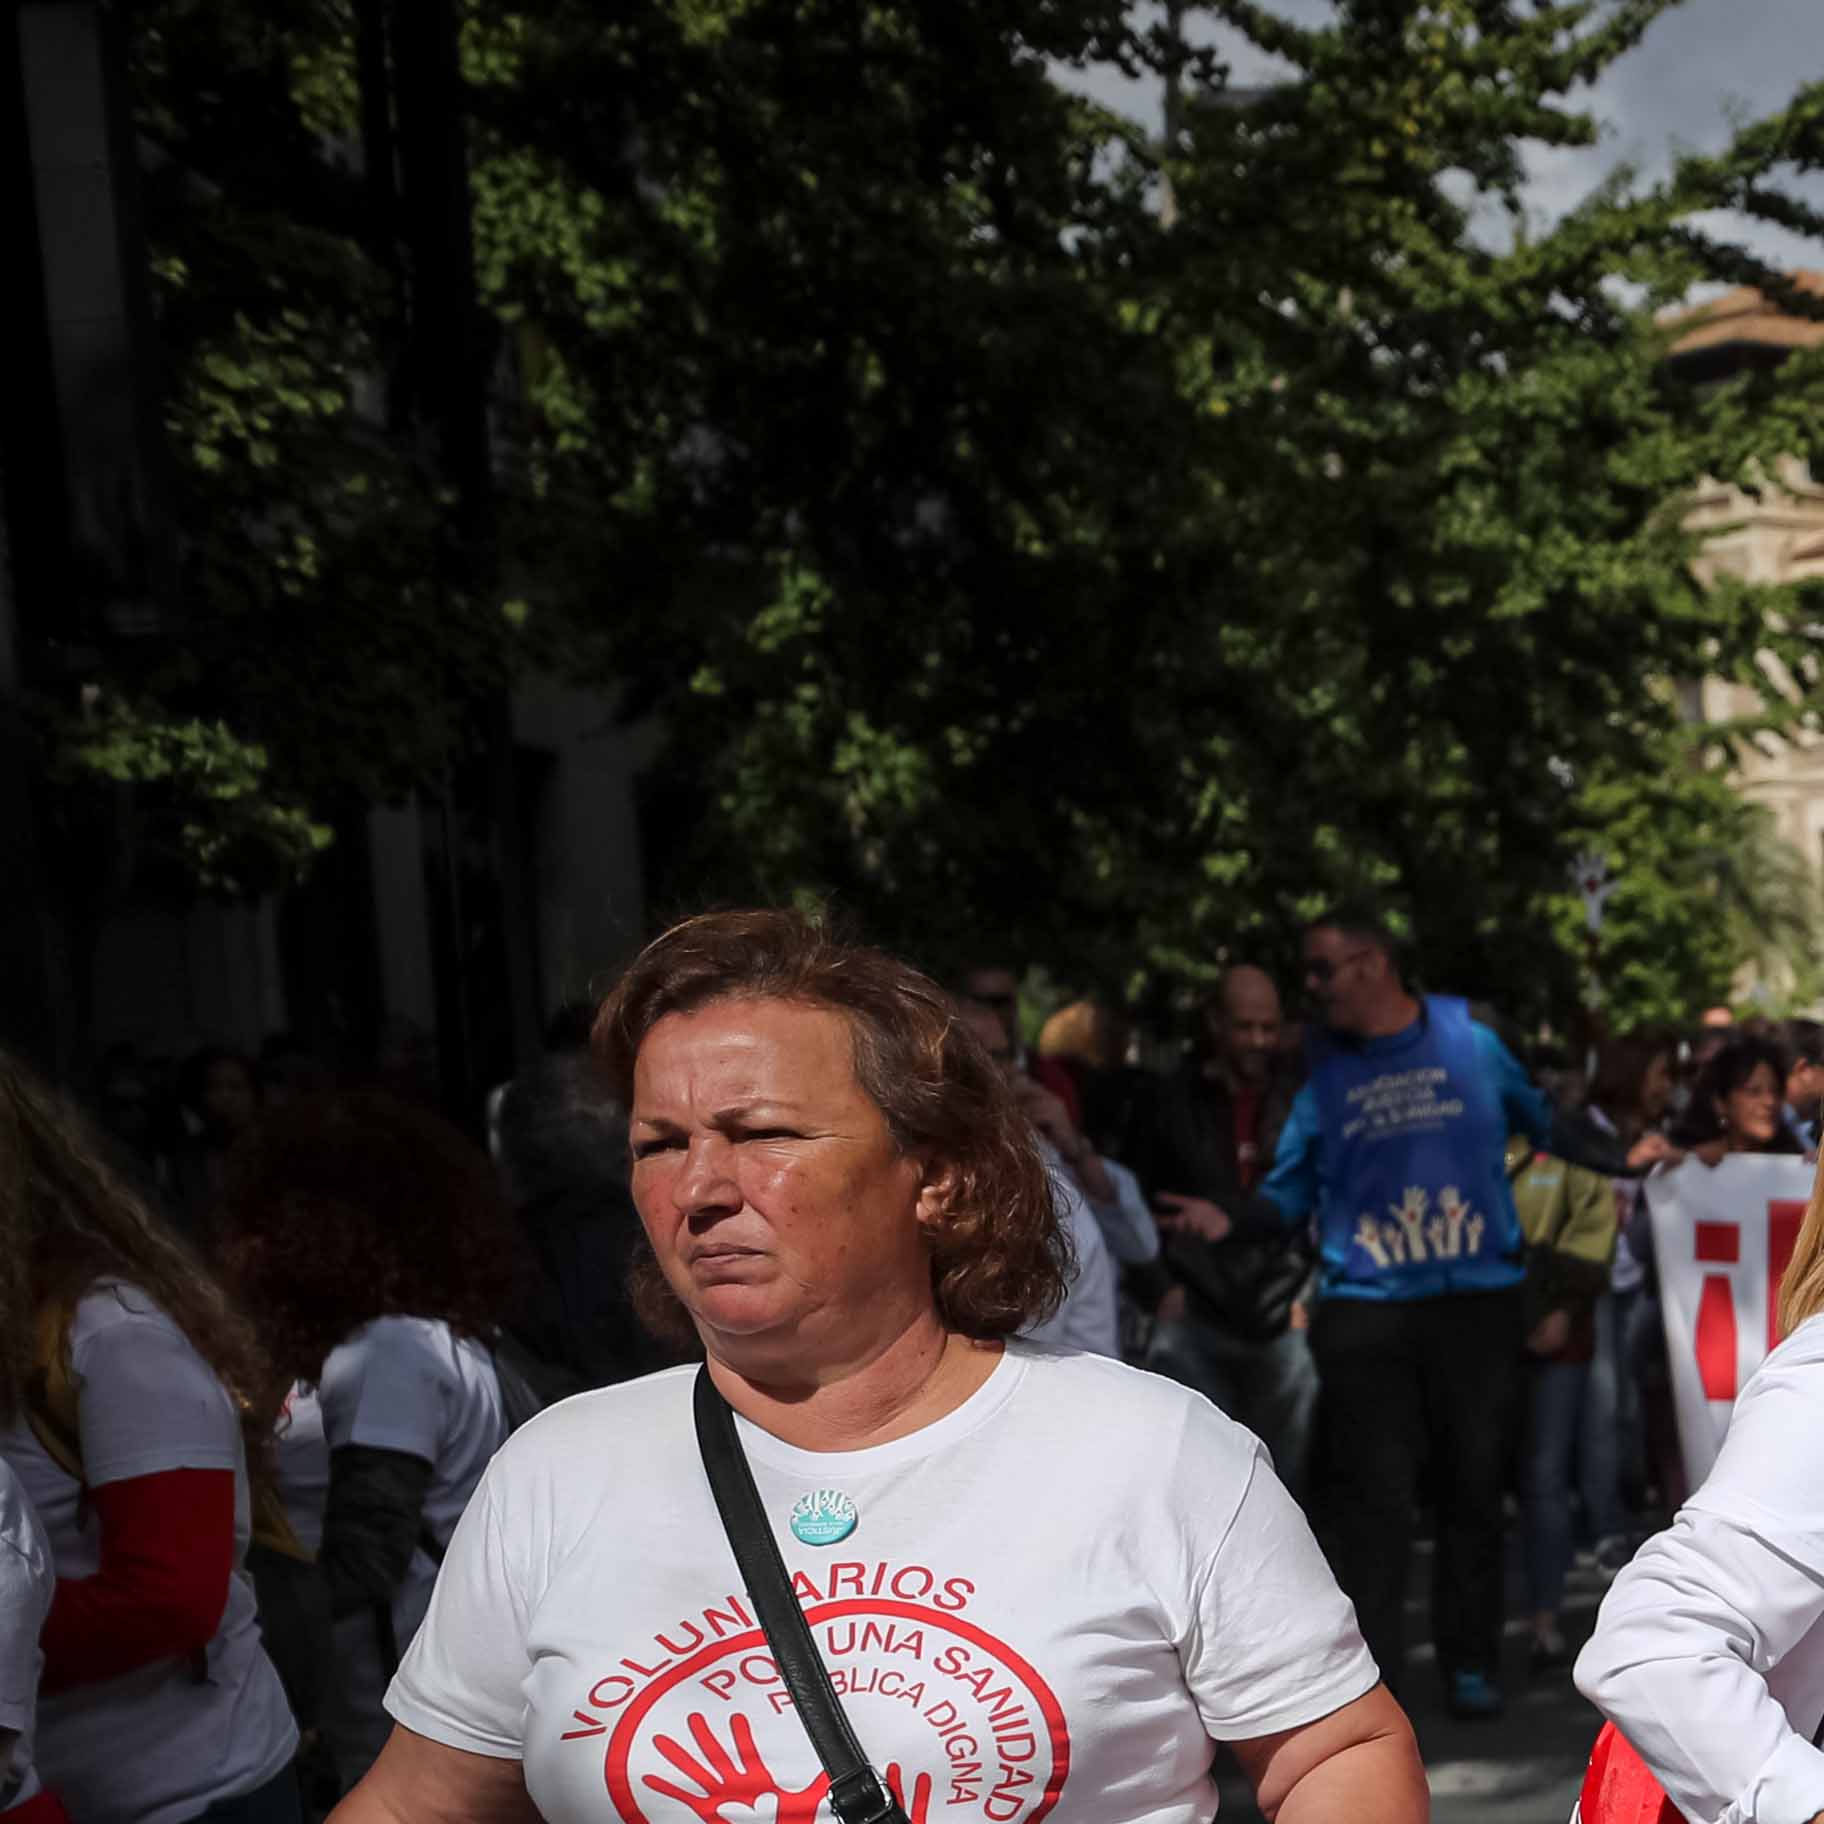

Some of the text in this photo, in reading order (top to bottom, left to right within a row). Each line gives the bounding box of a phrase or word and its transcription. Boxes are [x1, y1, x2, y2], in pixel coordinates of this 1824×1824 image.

[560, 1562, 976, 1741] VOLUNARIOS
[700, 1621, 1037, 1822] PO UNA SANIDAD
[767, 1667, 983, 1805] PBLICA DIGNA
